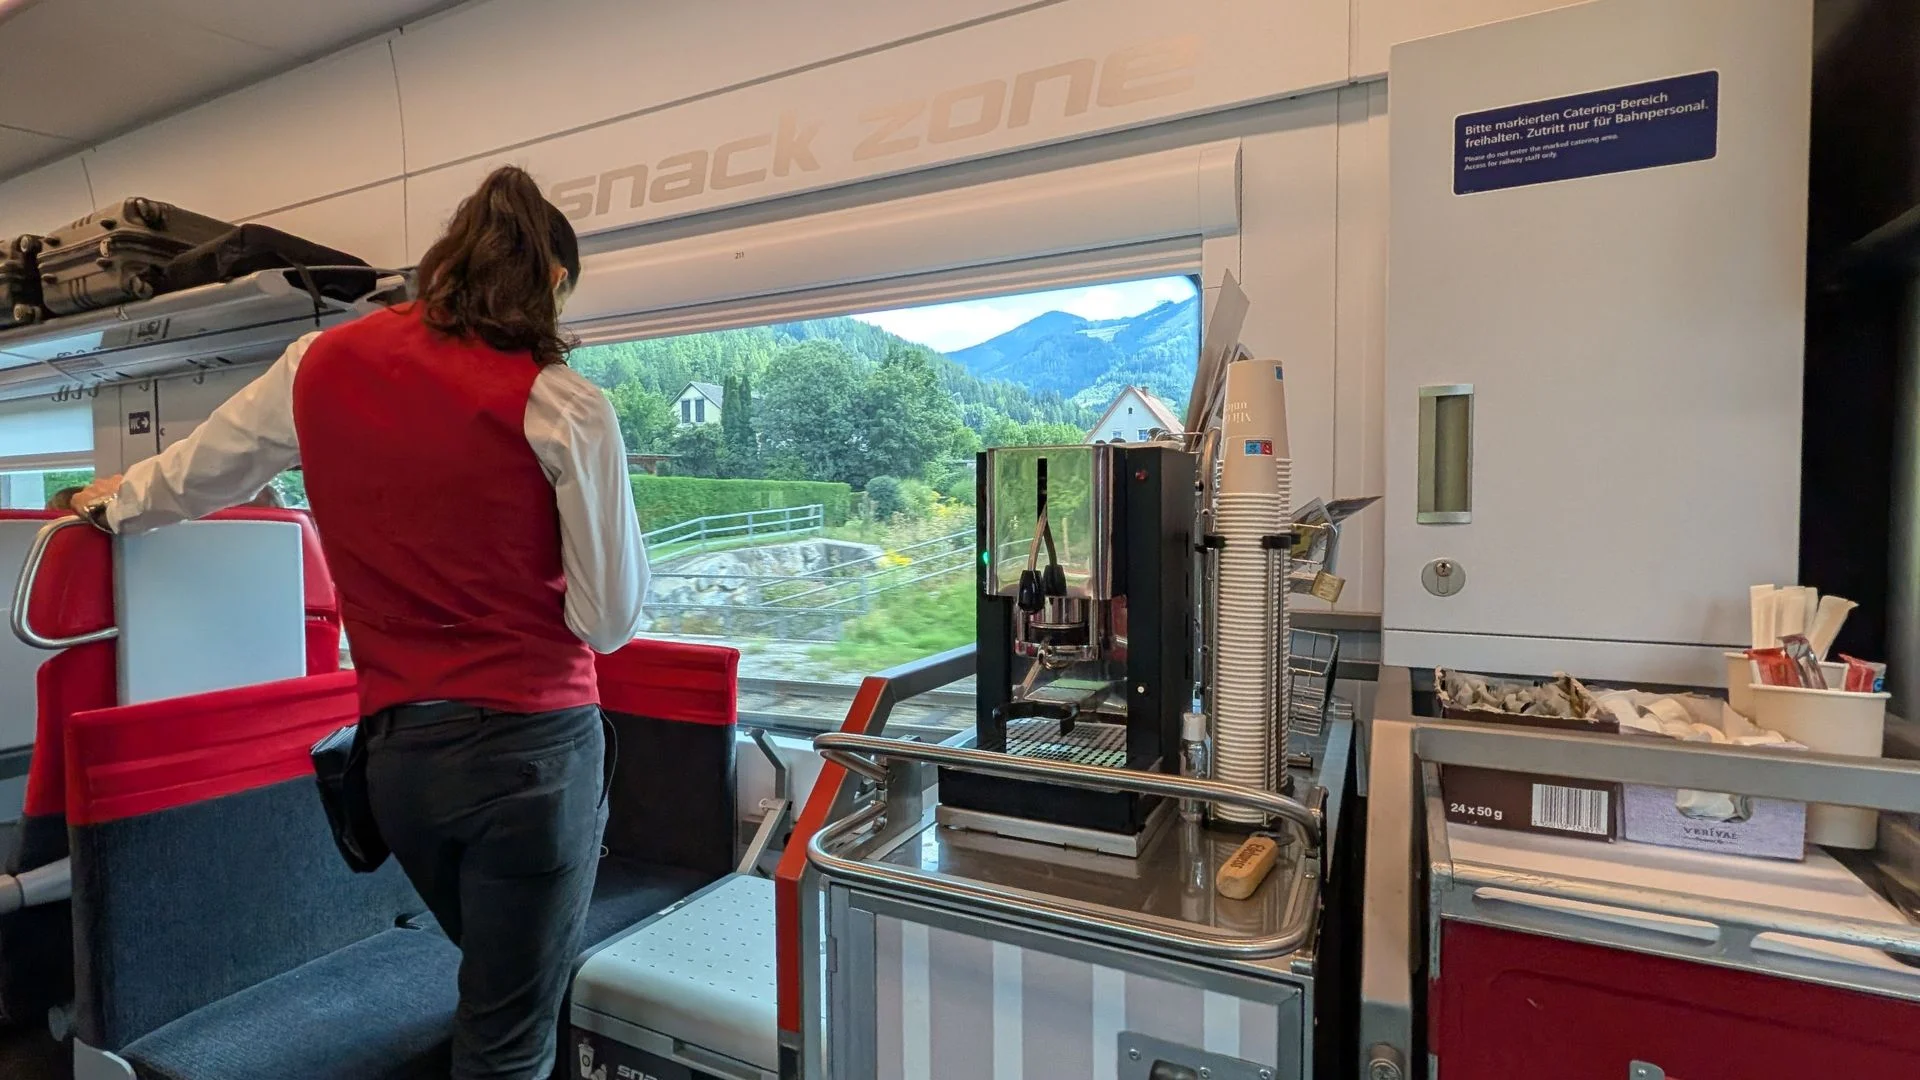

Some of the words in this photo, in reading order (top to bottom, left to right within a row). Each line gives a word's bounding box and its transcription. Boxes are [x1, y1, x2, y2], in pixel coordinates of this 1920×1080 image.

[549, 111, 821, 221] snack
[853, 37, 1199, 160] zone
[1465, 124, 1492, 135] Bitte
[1495, 112, 1560, 130] markierten
[1563, 92, 1668, 118] Catering-Bereich
[1465, 132, 1523, 148] freihalten.
[1527, 123, 1565, 138] Zutritt
[1568, 121, 1590, 132] nur
[1594, 116, 1612, 127] für
[1615, 99, 1709, 123] Bahnpersonal.
[1464, 154, 1485, 163] Please
[1497, 150, 1509, 158] not
[1510, 147, 1528, 155] enter
[1543, 140, 1569, 151] marked
[1570, 136, 1600, 146] catering
[1464, 163, 1487, 171] Access
[1487, 160, 1498, 168] for
[1499, 157, 1523, 166] railway
[1525, 153, 1541, 161] staff
[1450, 803, 1465, 814] 24
[1477, 807, 1492, 817] 50
[1494, 810, 1503, 821] g
